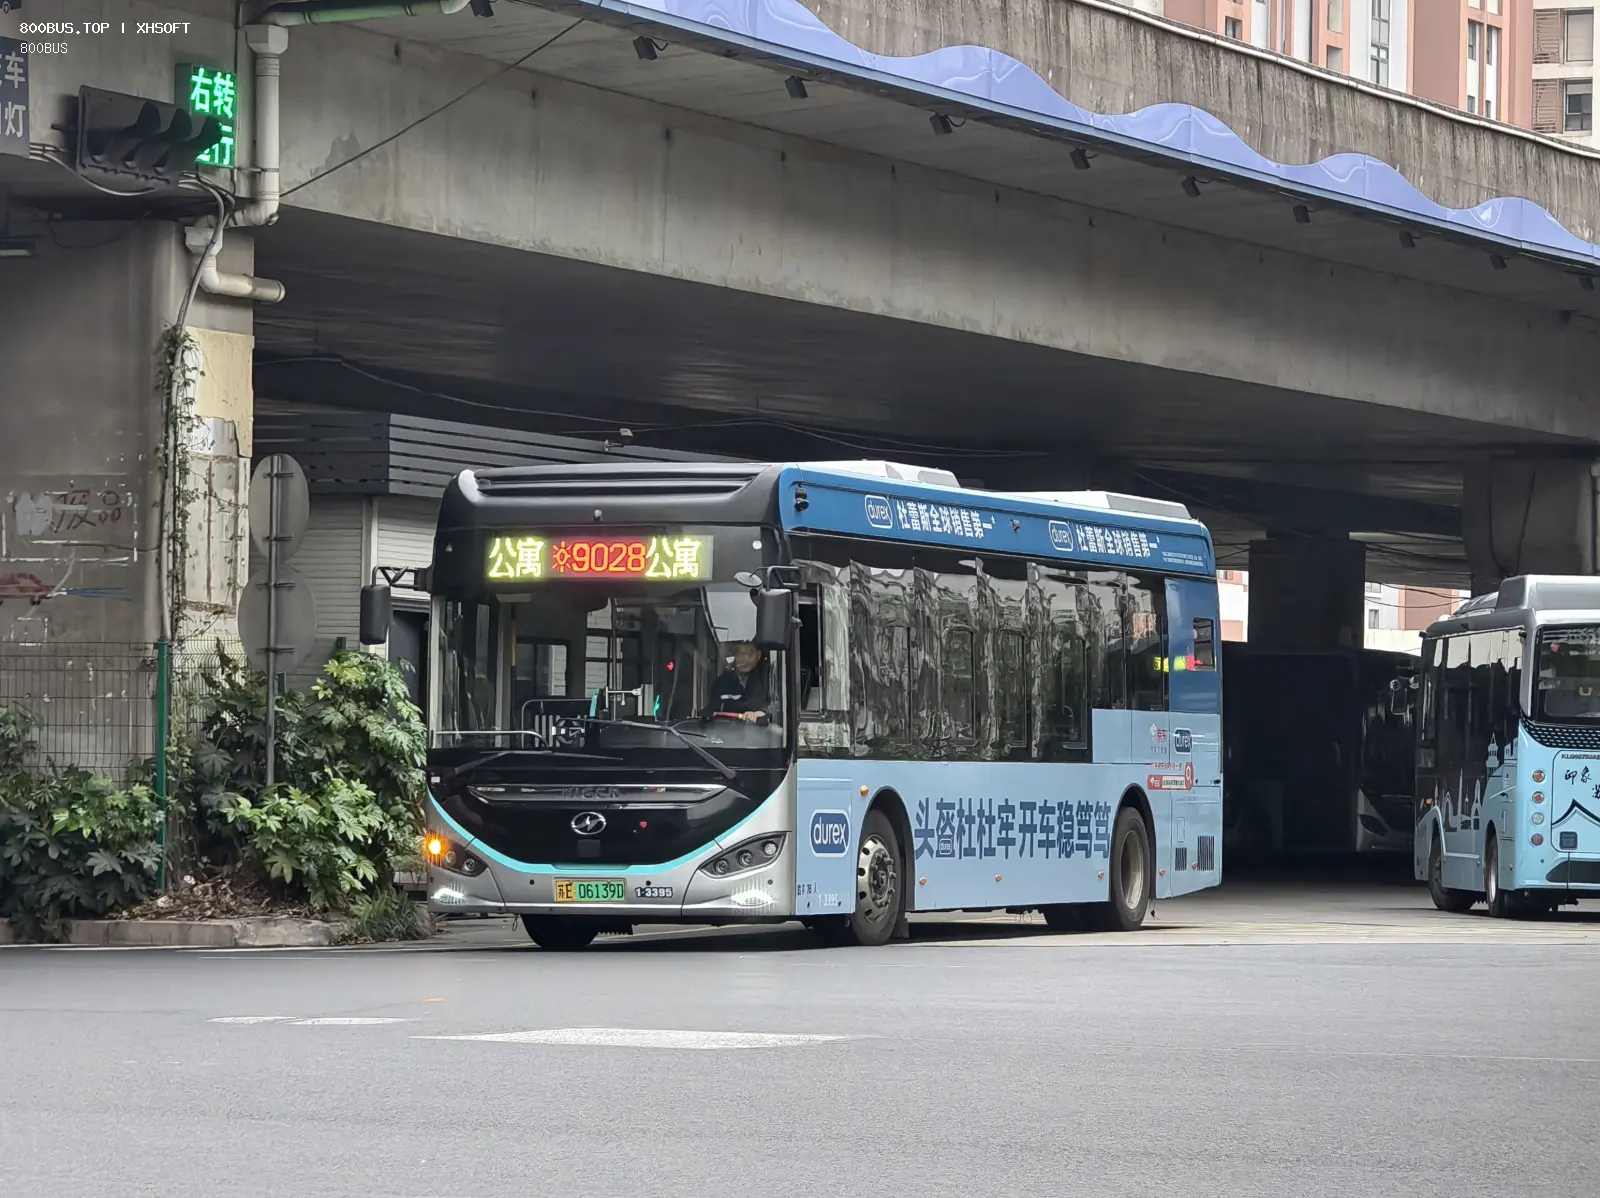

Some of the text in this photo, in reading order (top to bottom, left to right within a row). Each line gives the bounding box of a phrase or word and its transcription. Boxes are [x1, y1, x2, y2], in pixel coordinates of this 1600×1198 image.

[0, 51, 26, 89] 车
[190, 67, 236, 119] 右转
[0, 101, 26, 138] 灯
[867, 501, 890, 522] durex
[1051, 524, 1071, 544] durex
[487, 536, 703, 579] 公寓 9028 公寓
[812, 816, 848, 847] durex
[914, 797, 1112, 860] 头盔杜杜牢开车稳笃笃
[578, 882, 624, 899] 06139D
